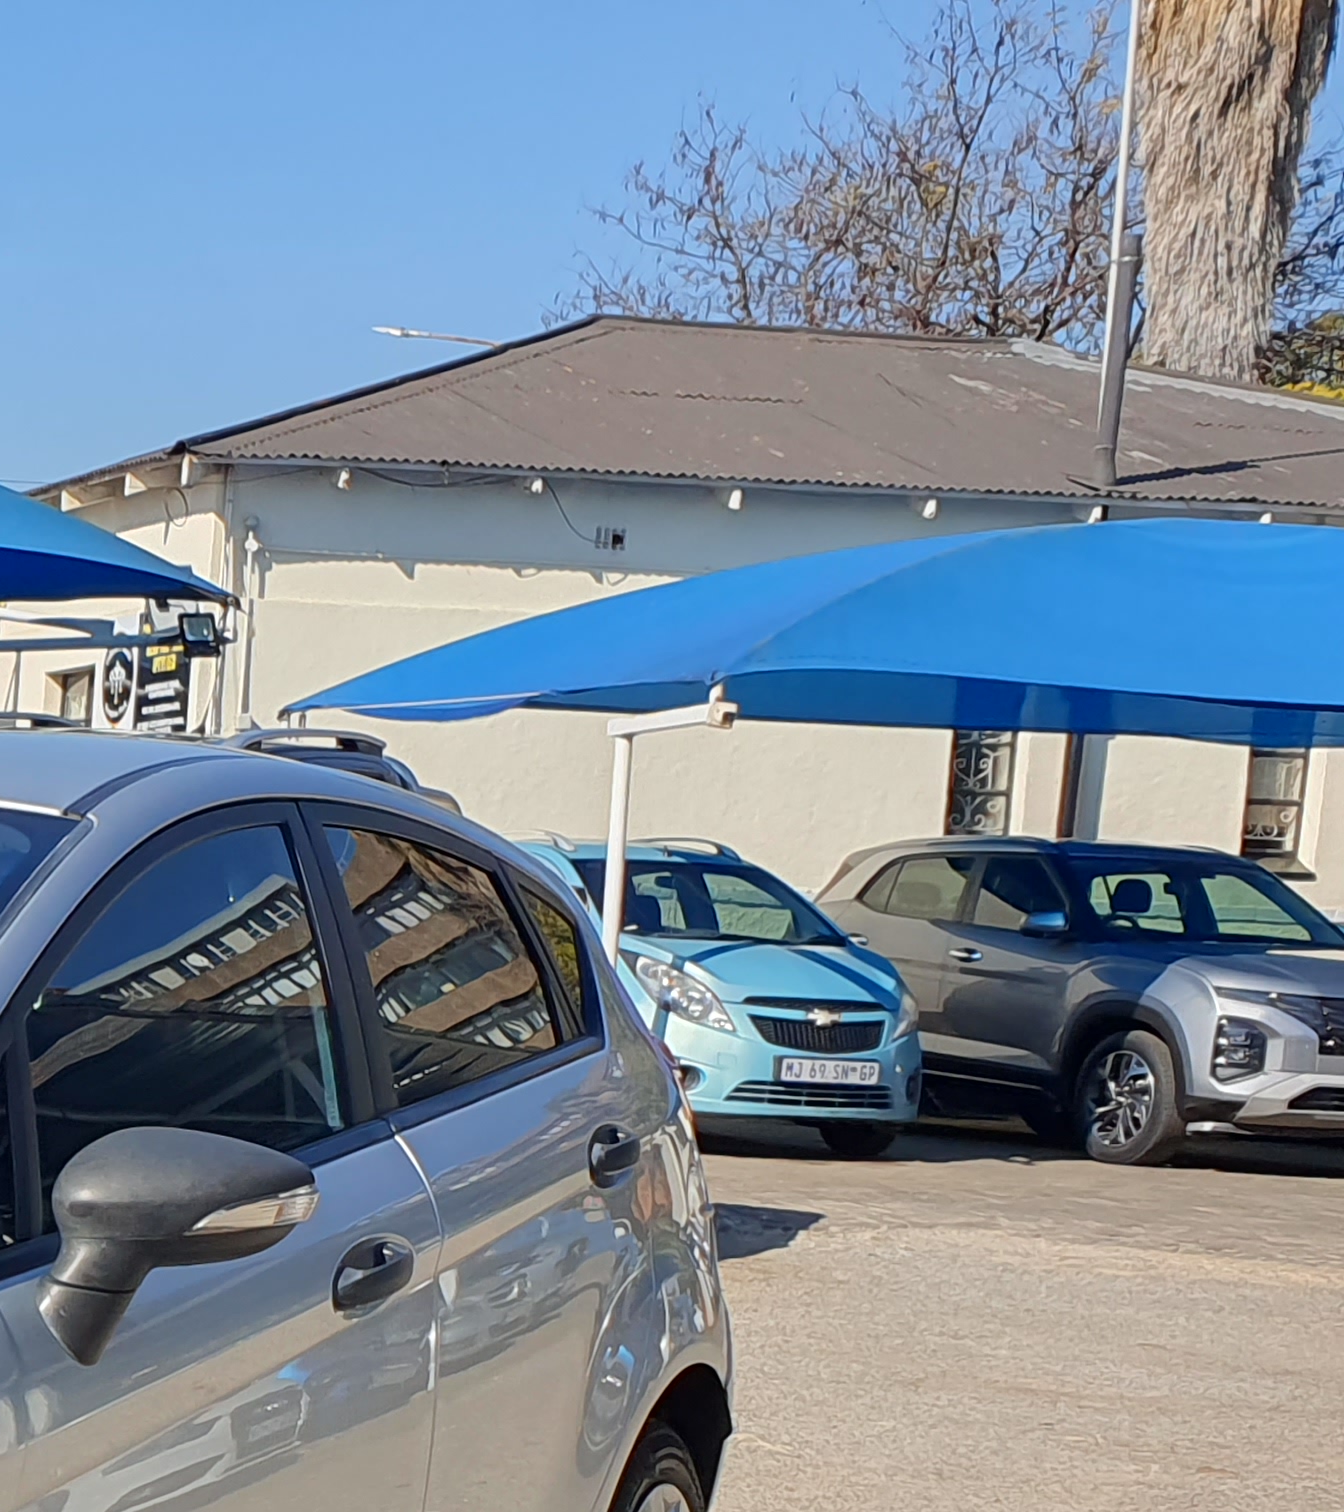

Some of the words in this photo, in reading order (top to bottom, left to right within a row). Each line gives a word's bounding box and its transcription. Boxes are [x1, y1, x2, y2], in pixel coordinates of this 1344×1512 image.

[809, 1062, 826, 1079] 69
[832, 1064, 849, 1080] SN
[859, 1065, 875, 1081] GP
